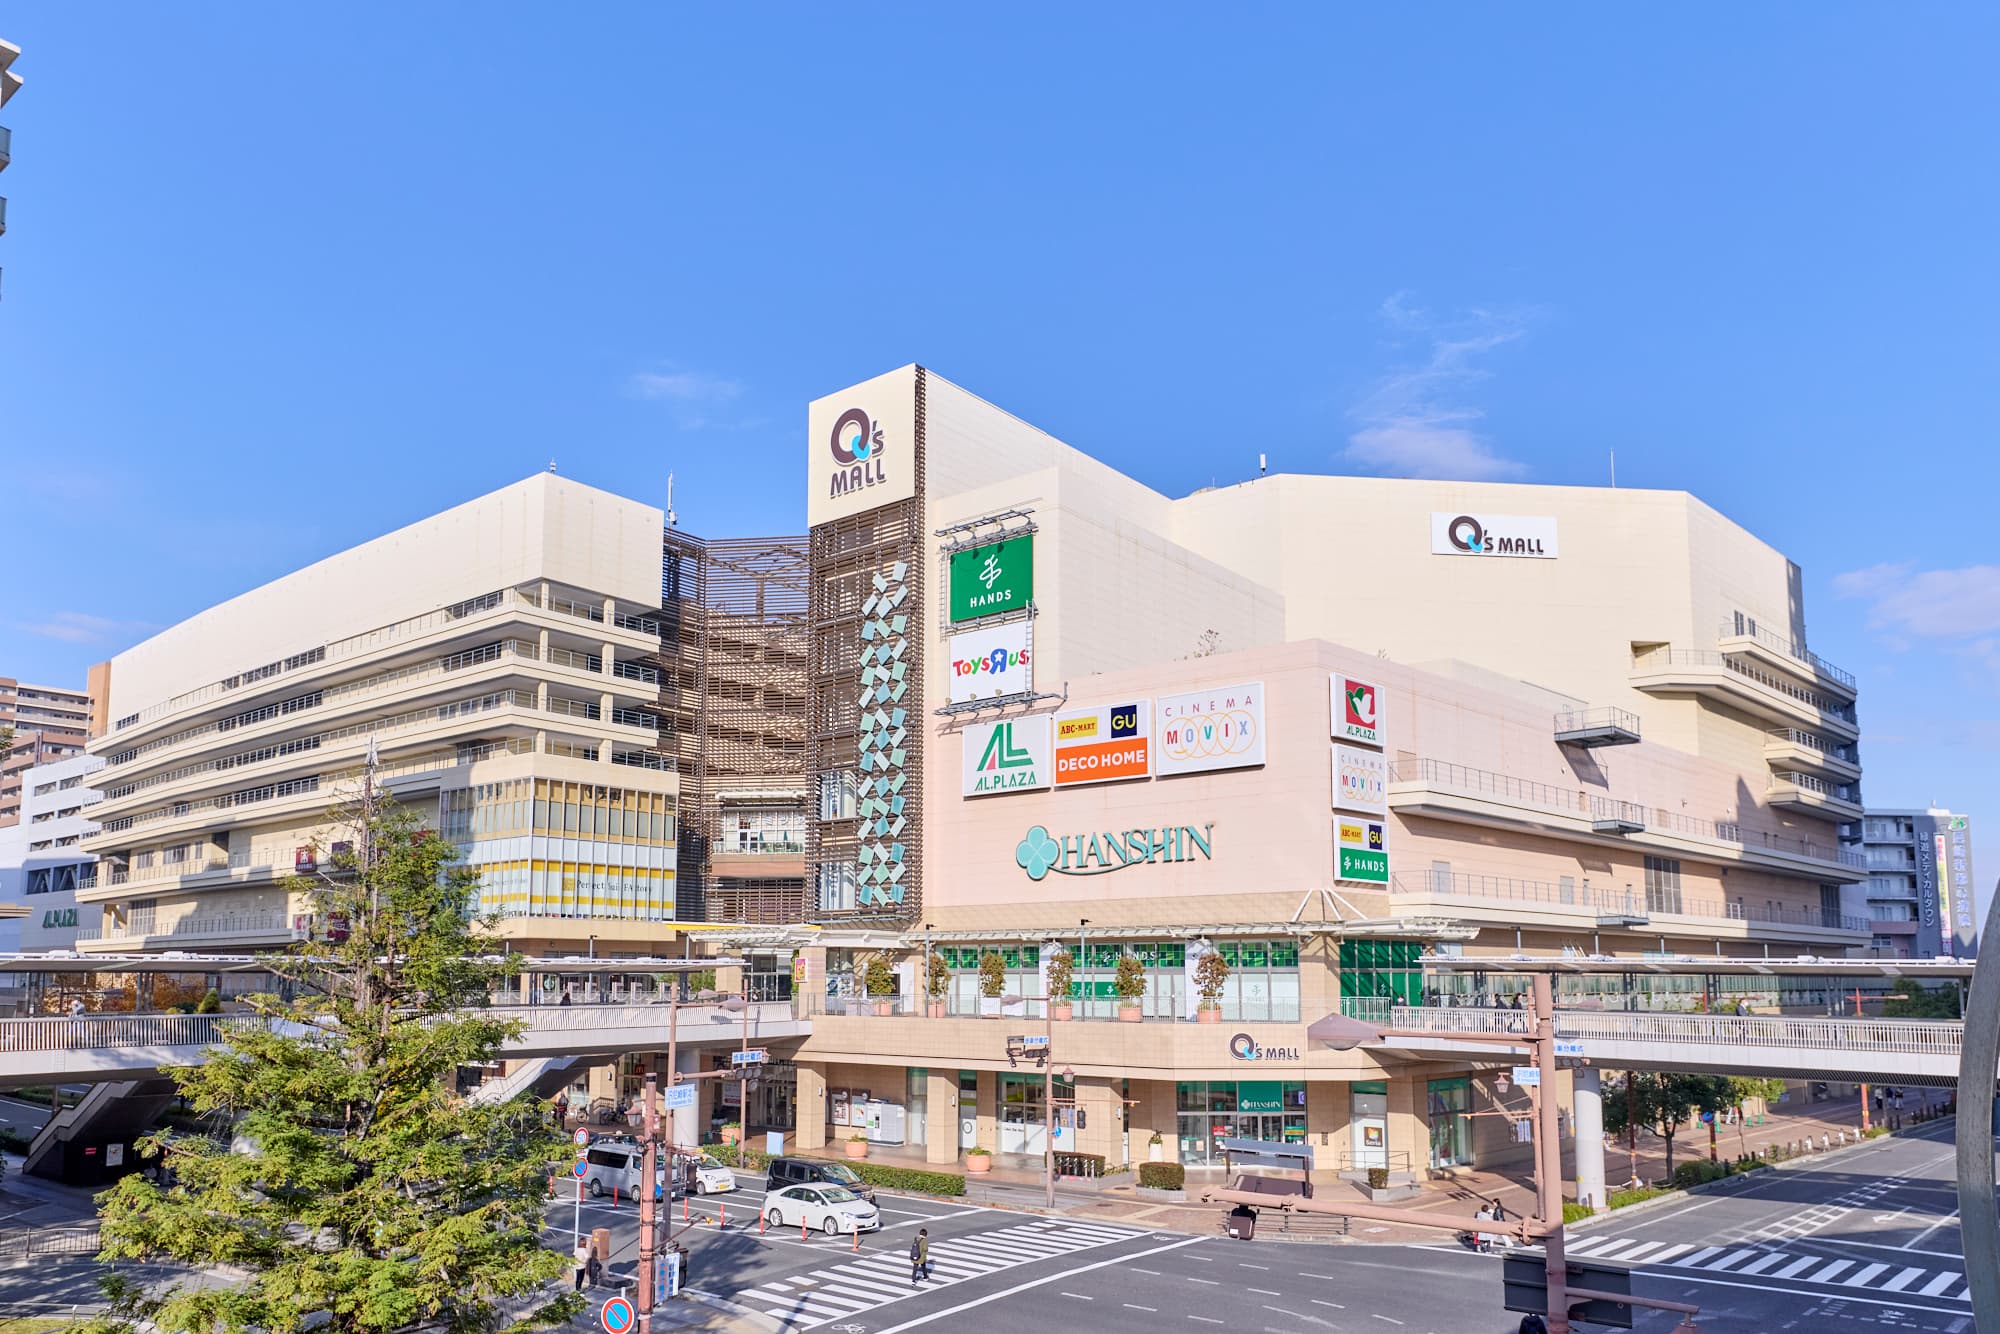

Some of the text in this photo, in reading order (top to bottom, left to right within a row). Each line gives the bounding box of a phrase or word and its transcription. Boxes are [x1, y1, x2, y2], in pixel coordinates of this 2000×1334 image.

[830, 408, 884, 463] Q's
[830, 458, 886, 497] MALL
[1448, 515, 1544, 553] Q's MALL
[970, 589, 1012, 608] HANDS
[1164, 695, 1253, 717] CINEMA
[1060, 713, 1137, 735] ABC-MART GU
[1166, 719, 1249, 746] MOVIX
[1058, 749, 1145, 772] DECO HOME
[1341, 754, 1383, 770] CINEMA
[974, 771, 1037, 792] AL.PLAZA
[1342, 775, 1382, 793] MOVIX
[1060, 823, 1214, 870] HANSHIN
[1369, 830, 1383, 845] GU
[1354, 857, 1385, 873] HANDS
[1230, 1033, 1300, 1059] Q's MALL
